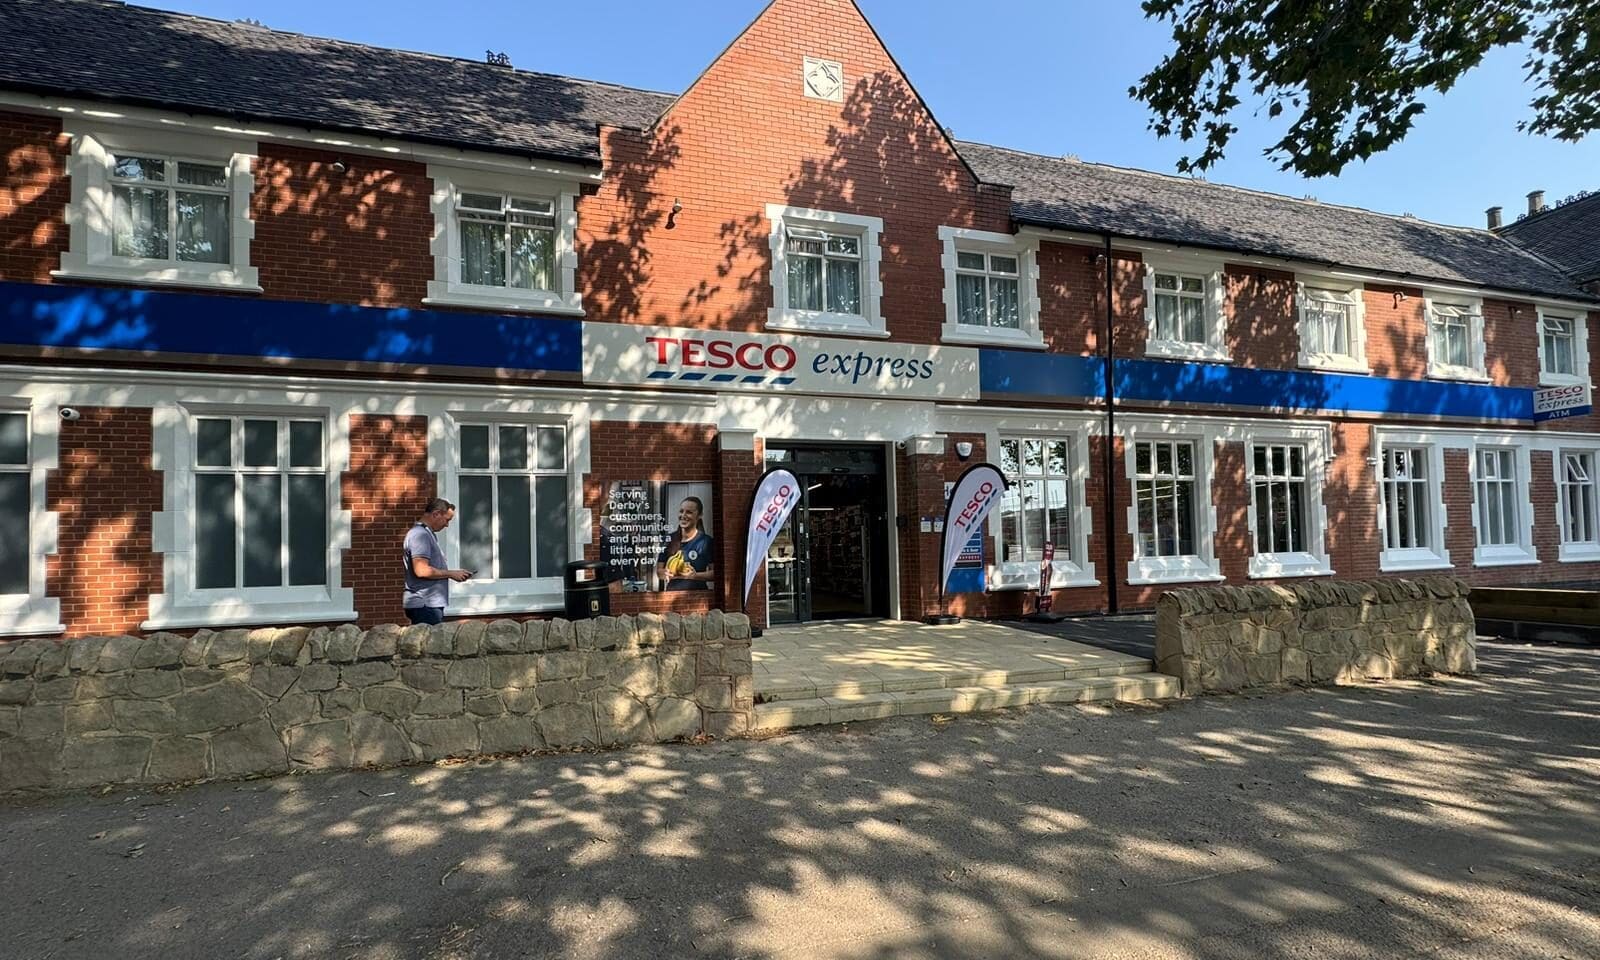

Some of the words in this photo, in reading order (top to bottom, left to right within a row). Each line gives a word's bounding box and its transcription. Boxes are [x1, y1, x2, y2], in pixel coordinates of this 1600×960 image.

[645, 337, 797, 372] TESCO
[812, 351, 933, 384] express
[1537, 386, 1583, 398] TESCO
[1538, 397, 1584, 409] express
[1549, 410, 1570, 419] ATM
[609, 489, 648, 501] Serving
[609, 501, 650, 512] Derby's
[756, 485, 790, 532] TESCO
[954, 482, 993, 528] TESCO
[609, 512, 666, 521] customers,
[609, 523, 674, 532] communities
[609, 534, 629, 543] and
[632, 534, 664, 545] planet
[665, 535, 672, 543] a
[610, 545, 633, 554] little
[635, 544, 667, 554] better
[610, 557, 639, 567] every
[640, 555, 658, 567] day
